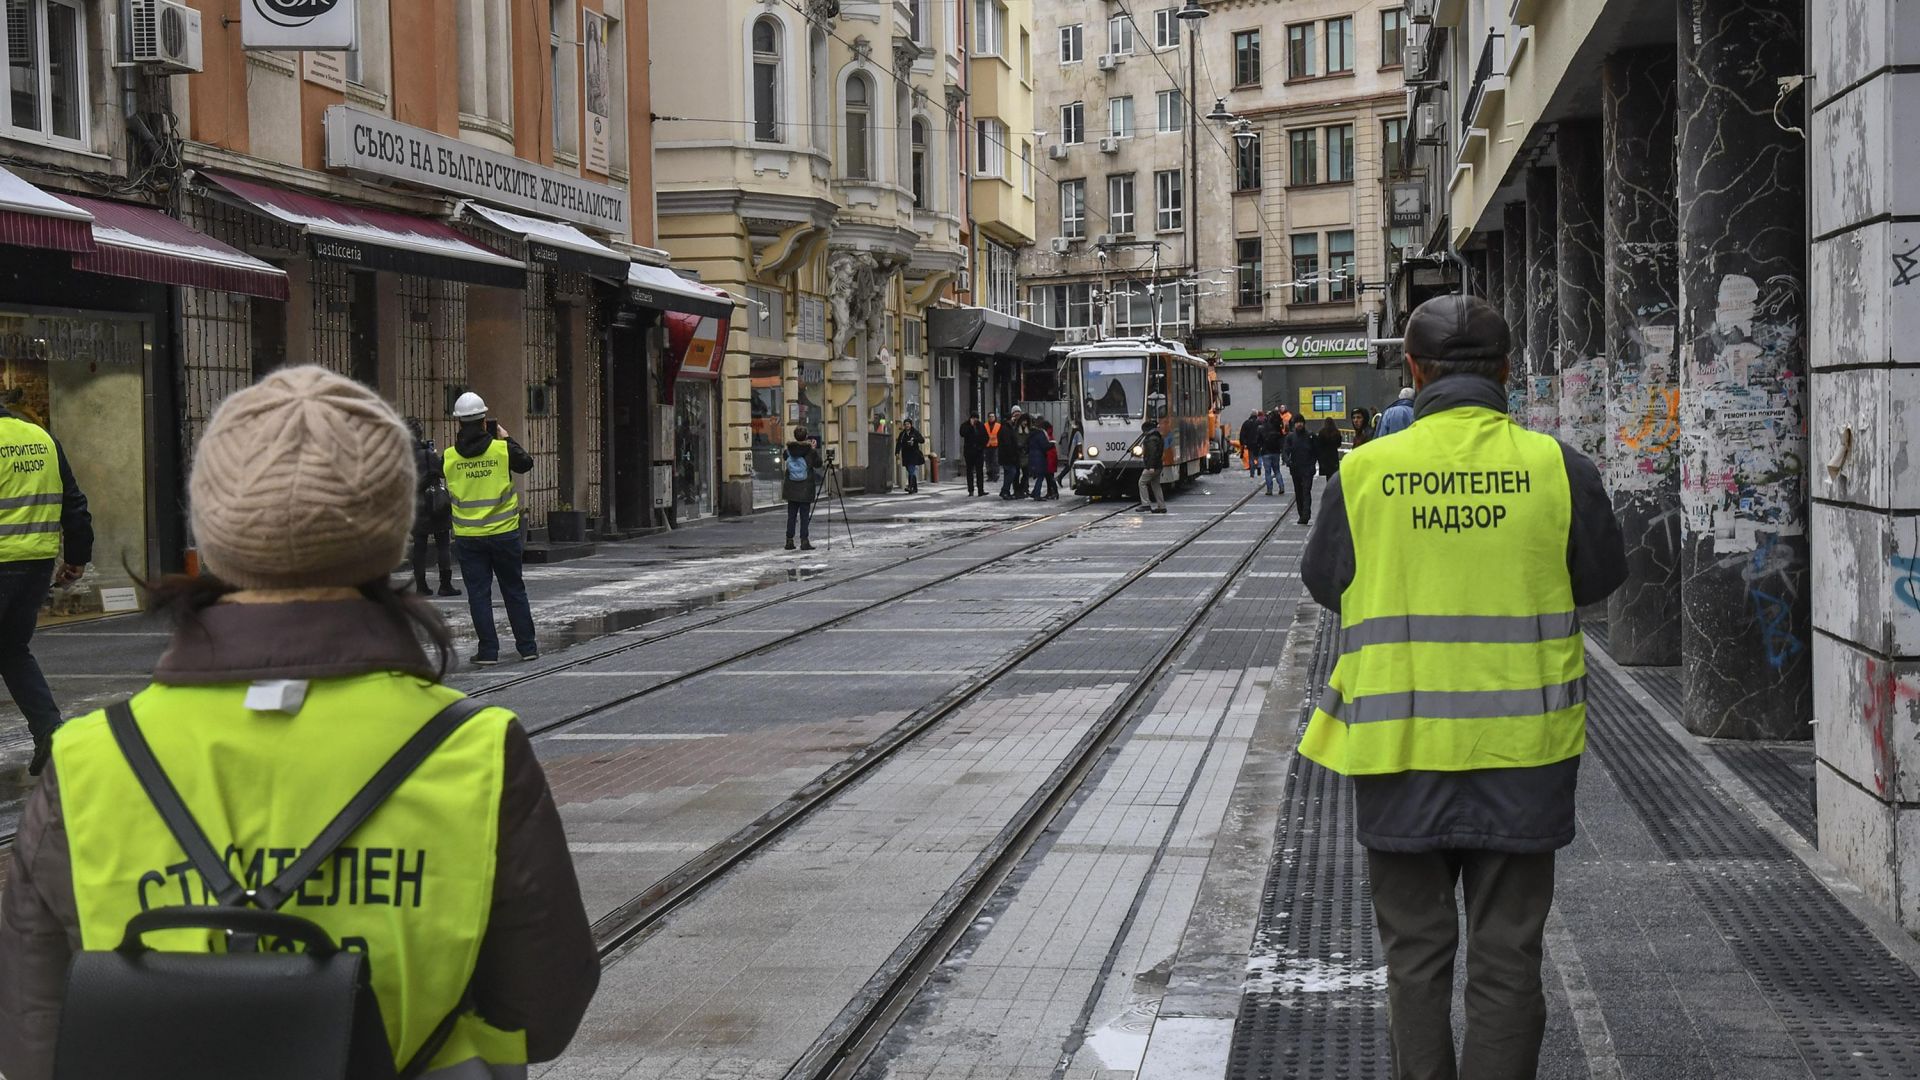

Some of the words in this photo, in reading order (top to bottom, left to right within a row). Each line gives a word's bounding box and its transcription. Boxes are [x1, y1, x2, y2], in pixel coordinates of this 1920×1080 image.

[354, 124, 404, 165] СЪЮЗ
[409, 139, 434, 173] НА
[437, 147, 538, 200] БЪЛГАРСКИТЕ
[540, 177, 622, 223] ЖУРНАЛИСТИ
[1393, 213, 1421, 221] RADO
[317, 242, 361, 261] pasticceria
[1302, 336, 1344, 353] банка
[1345, 337, 1367, 351] ДС
[0, 443, 48, 458] СТРОИТЕЛЕН
[1105, 441, 1126, 451] 3002
[13, 459, 44, 474] НАДЗОР
[456, 460, 498, 470] СТРОИТЕЛЕН
[465, 470, 492, 478] НАДЗОР
[1381, 470, 1530, 497] СТРОИТЕЛЕН
[1412, 505, 1506, 533] НАДЗОР
